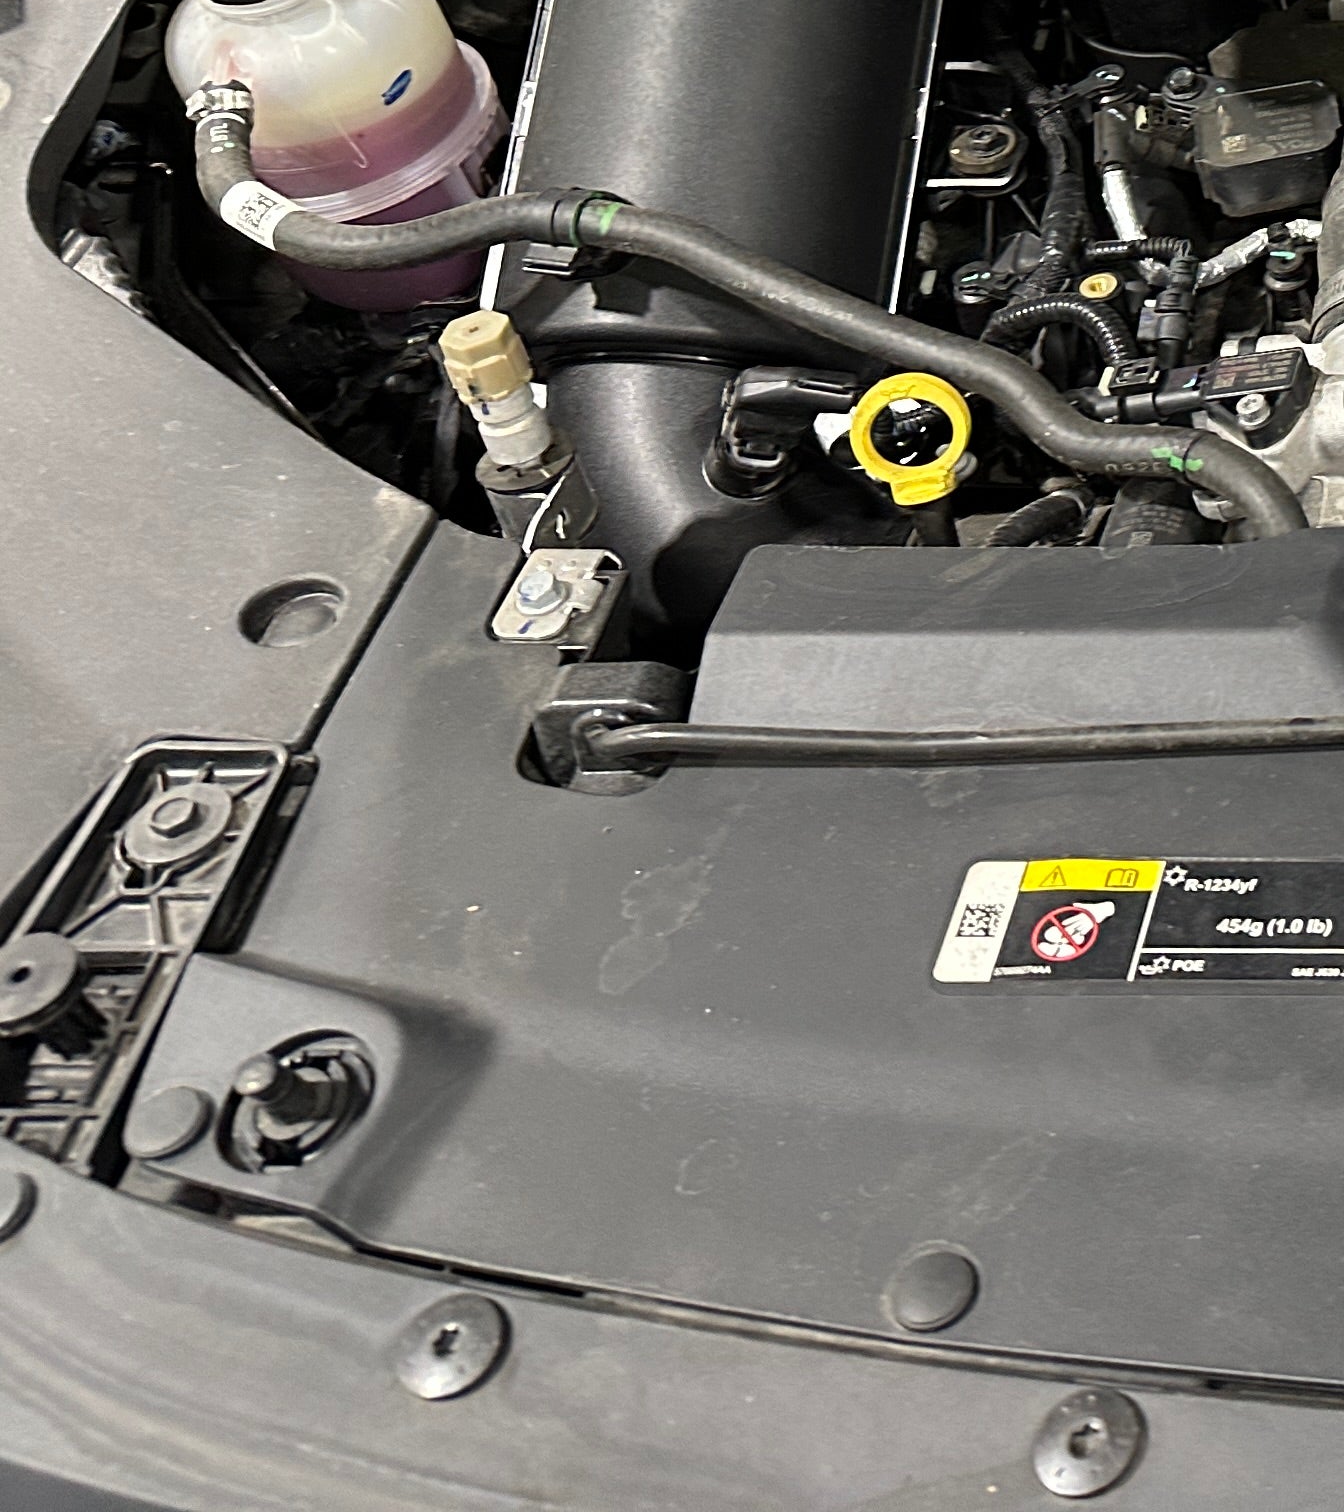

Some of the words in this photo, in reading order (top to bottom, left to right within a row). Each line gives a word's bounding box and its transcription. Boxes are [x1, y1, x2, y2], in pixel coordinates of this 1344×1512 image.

[1184, 878, 1258, 894] R-1234yf
[1216, 919, 1264, 937] 454g
[1266, 919, 1303, 937] (1.0
[1306, 919, 1333, 937] lb)
[1171, 959, 1205, 972] POE
